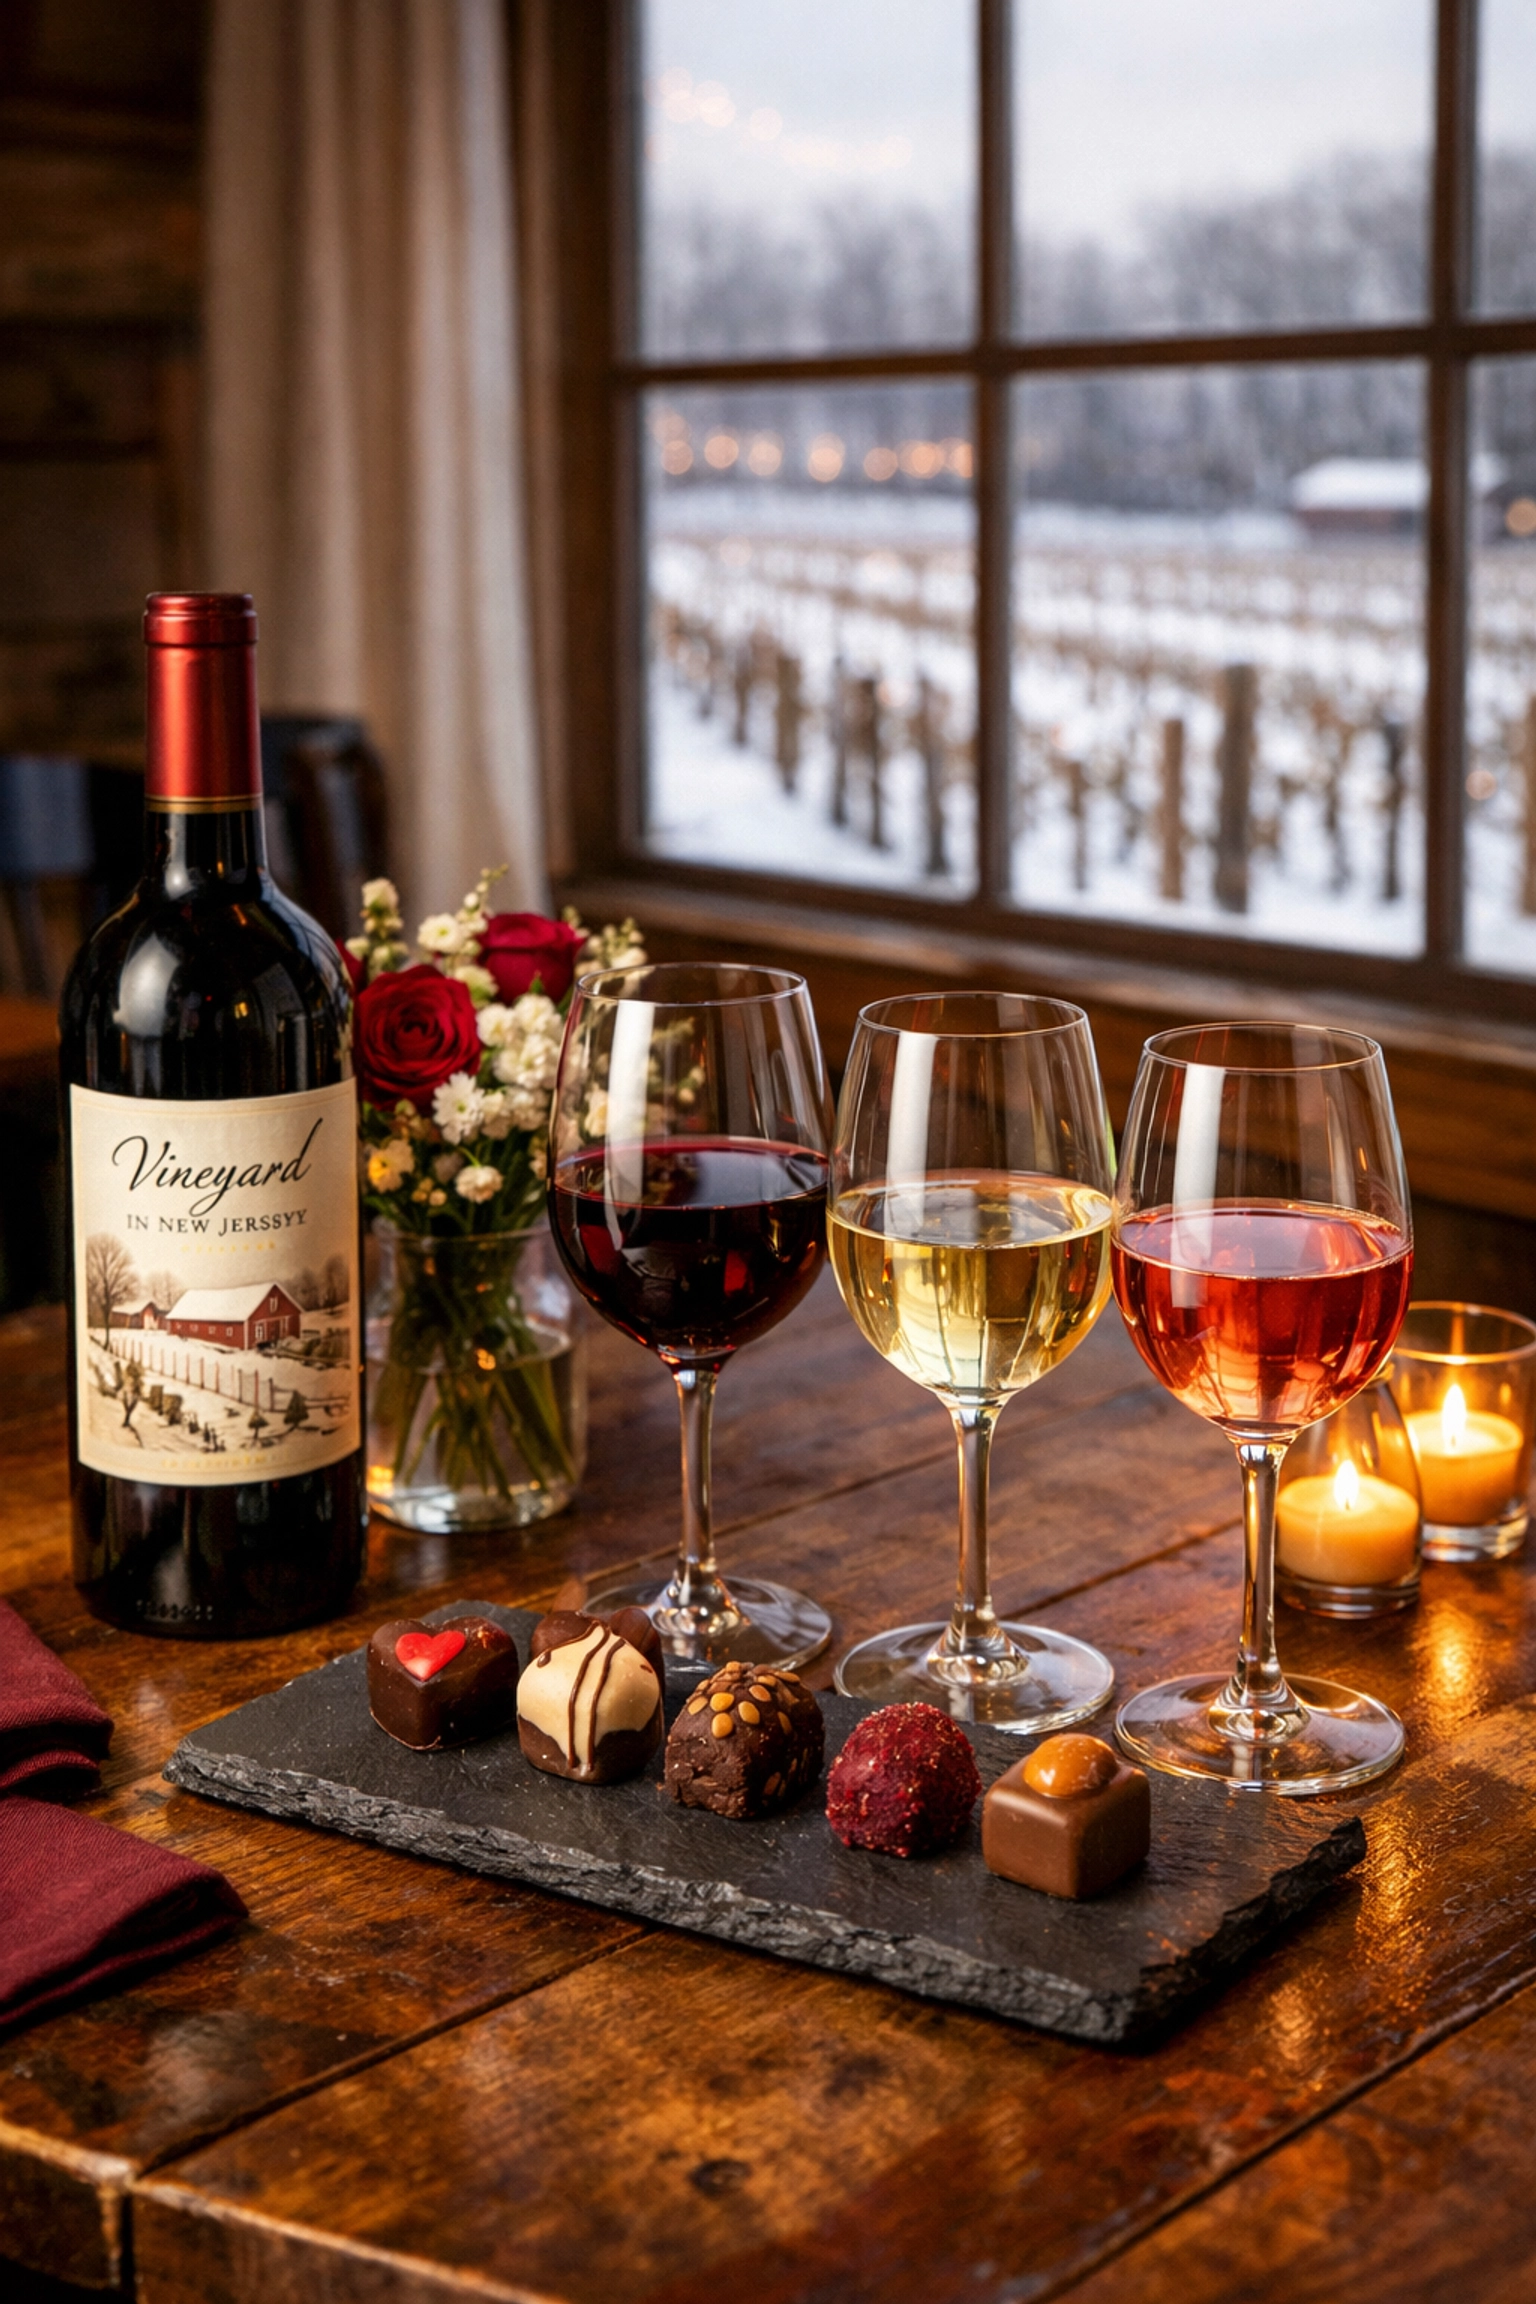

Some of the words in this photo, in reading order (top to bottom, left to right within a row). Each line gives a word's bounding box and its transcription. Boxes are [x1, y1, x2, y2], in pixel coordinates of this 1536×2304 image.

[112, 1117, 323, 1217] Vineyard
[127, 1214, 149, 1231] IN
[159, 1216, 210, 1233] NEW
